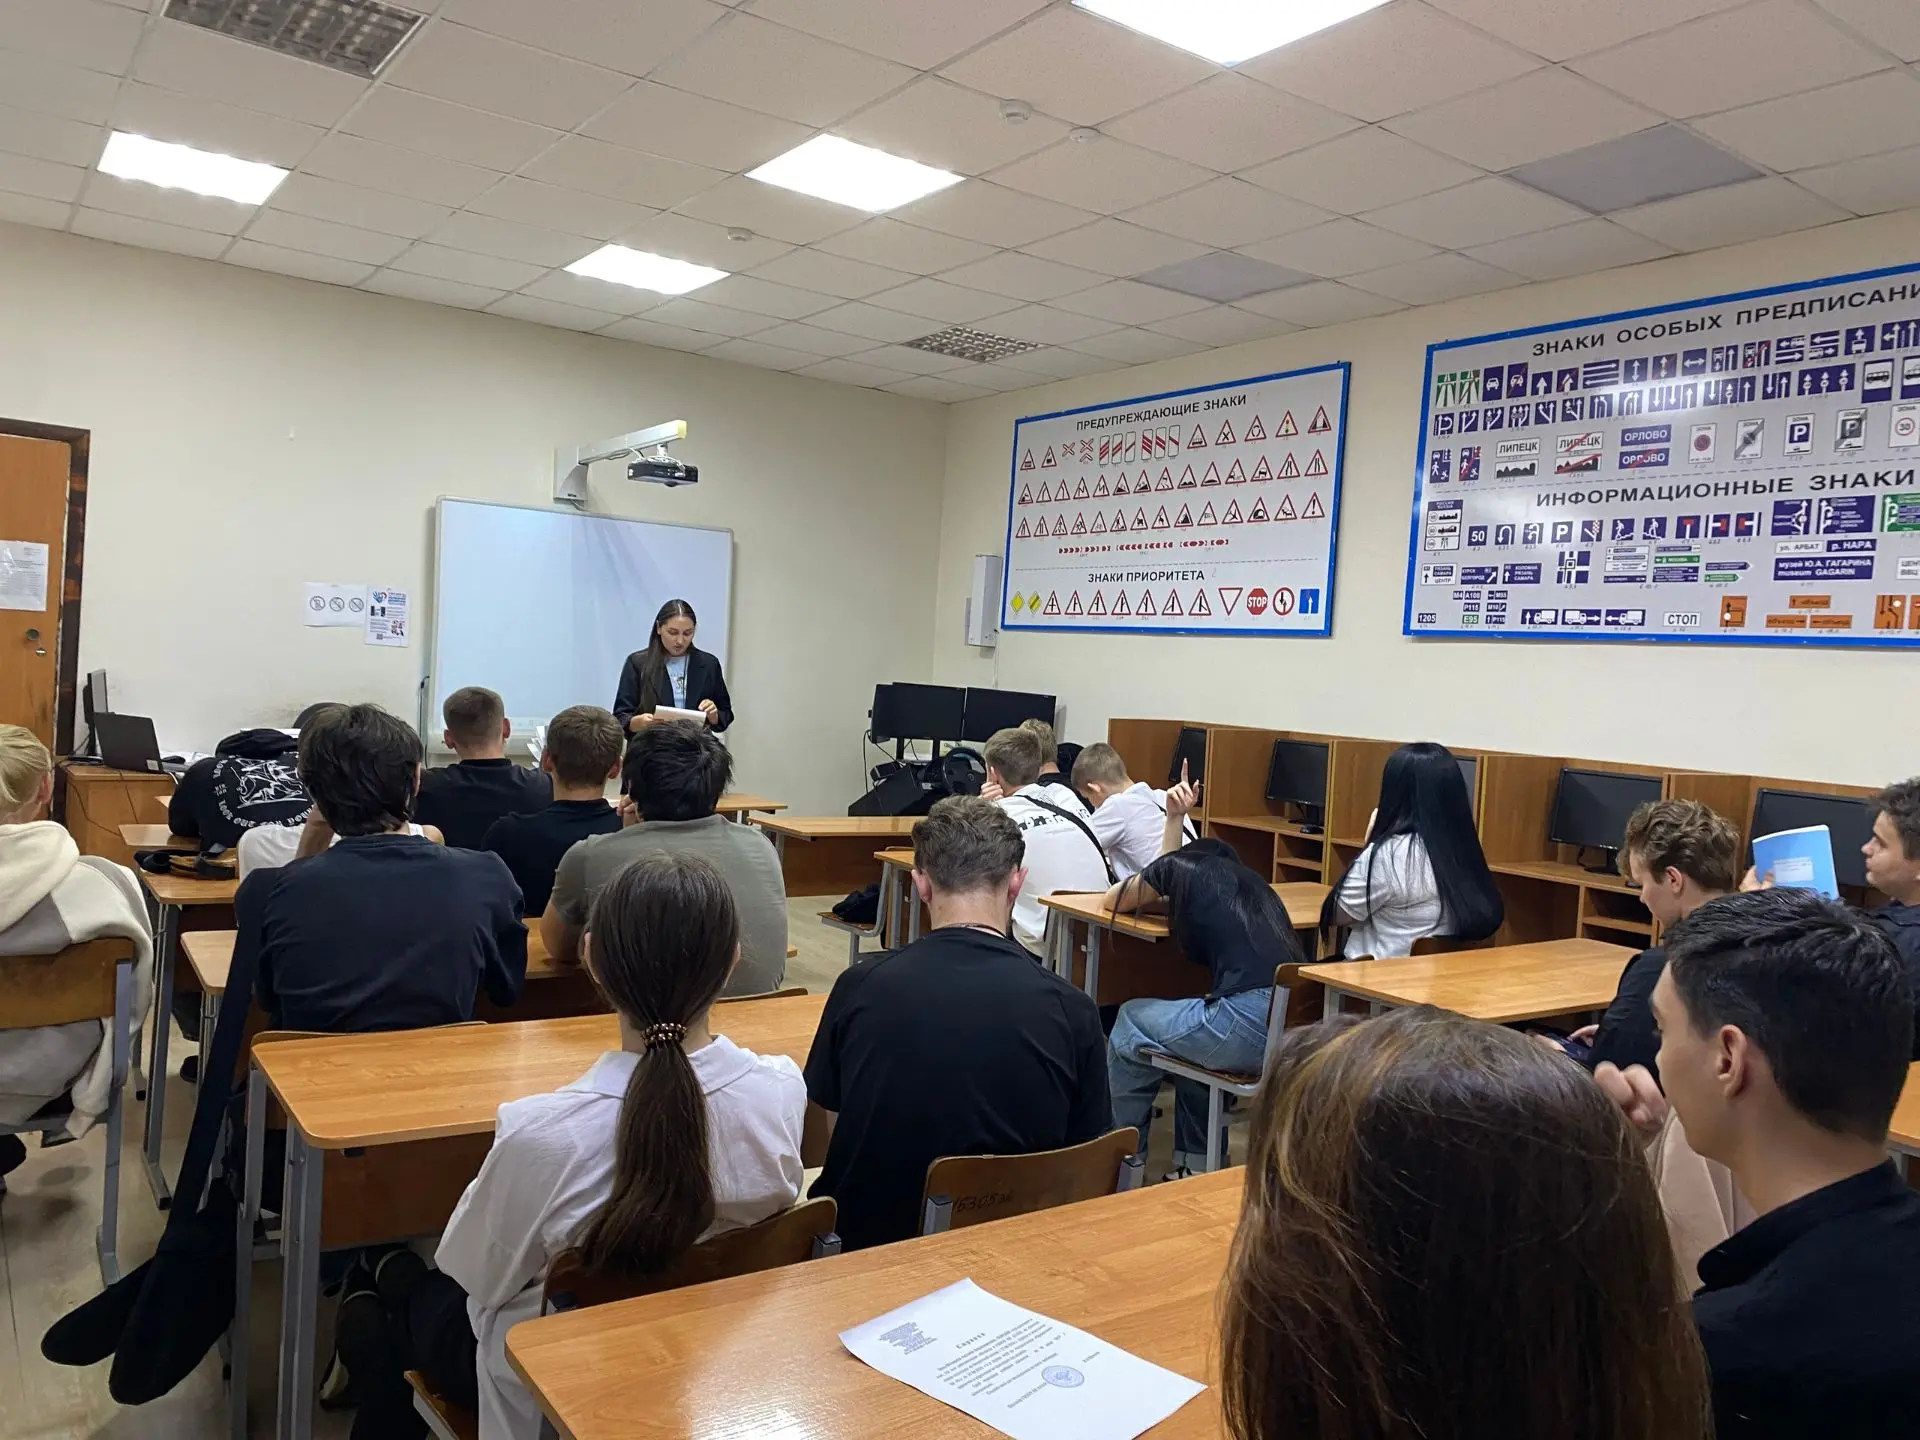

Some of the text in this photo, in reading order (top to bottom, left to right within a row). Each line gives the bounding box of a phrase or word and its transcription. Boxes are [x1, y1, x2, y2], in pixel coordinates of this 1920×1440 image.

[1532, 333, 1605, 357] ЗНАКИ
[1616, 314, 1724, 344] ОСОБЫХ
[1076, 394, 1247, 431] ПРЕДУПРЕЖДАЮЩИЕ ЗНАКИ
[1899, 423, 1911, 432] 30
[1623, 429, 1668, 442] ОРЛОВО
[1499, 440, 1538, 454] ЛИПЕЦК
[1558, 437, 1601, 450] ЛИПЕЦК
[1536, 469, 1915, 507] ИНФОРМАЦИОННЫЕ ЗНАКИ
[1470, 530, 1486, 542] 50
[1794, 543, 1819, 551] АРБАТ
[1842, 540, 1873, 549] НАРА
[1825, 559, 1872, 567] ГАГАРИНА
[1087, 570, 1205, 583] ЗНАКИ ПРИОРИТЕТА
[1247, 596, 1268, 608] STOP
[1418, 614, 1436, 622] 1205
[1667, 613, 1698, 625] СТОП
